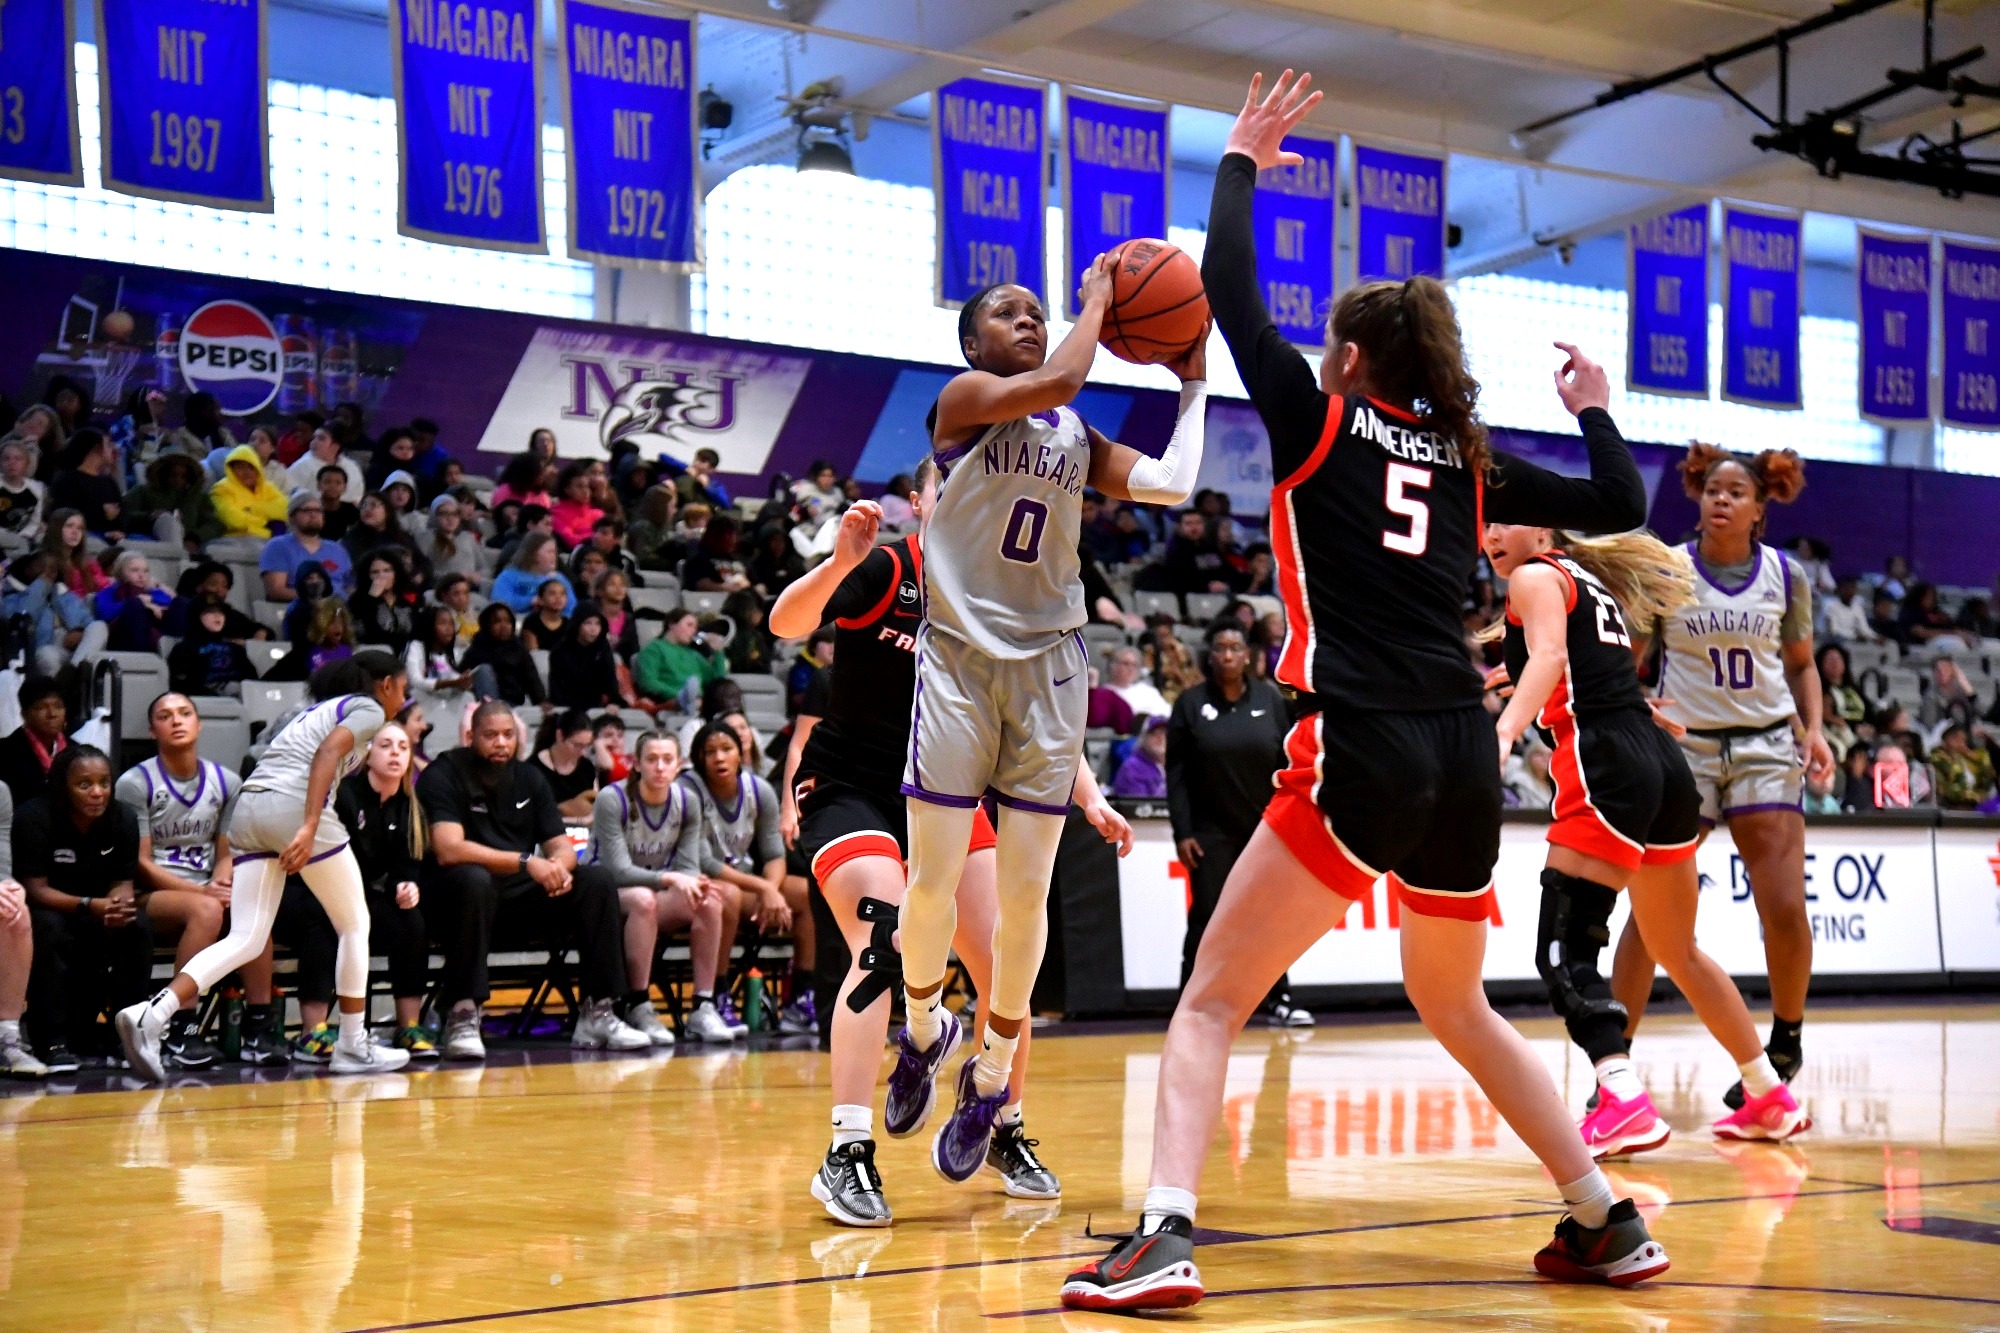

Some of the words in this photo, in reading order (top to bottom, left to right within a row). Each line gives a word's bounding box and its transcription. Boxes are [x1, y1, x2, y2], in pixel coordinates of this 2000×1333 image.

[158, 24, 207, 85] NIT
[405, 0, 530, 63] NIAGARA
[574, 23, 685, 89] NIAGARA
[448, 82, 492, 138] NIT
[613, 108, 653, 162] NIT
[943, 93, 1037, 152] NIAGARA
[150, 110, 221, 173] 1987
[1073, 116, 1161, 173] NIAGARA
[443, 161, 502, 219] 1976
[608, 184, 665, 240] 1972
[962, 169, 1020, 221] NCAA
[1101, 191, 1132, 237] NIT
[1361, 164, 1439, 217] NIAGARA
[967, 240, 1017, 287] 1970
[1274, 217, 1305, 262] NIT
[1385, 234, 1414, 277] NIT
[1730, 226, 1795, 273] NIAGARA
[1656, 274, 1682, 317] NIT
[1749, 288, 1775, 329] NIT
[1883, 312, 1907, 348] NIT
[1965, 317, 1988, 357] NIT
[187, 342, 277, 373] PEPSI
[1000, 496, 1050, 566] 0
[1381, 461, 1432, 556] 5
[1586, 584, 1632, 649] 23
[1706, 646, 1754, 691] 10
[1730, 854, 1818, 902] BE
[1834, 854, 1887, 902] OX
